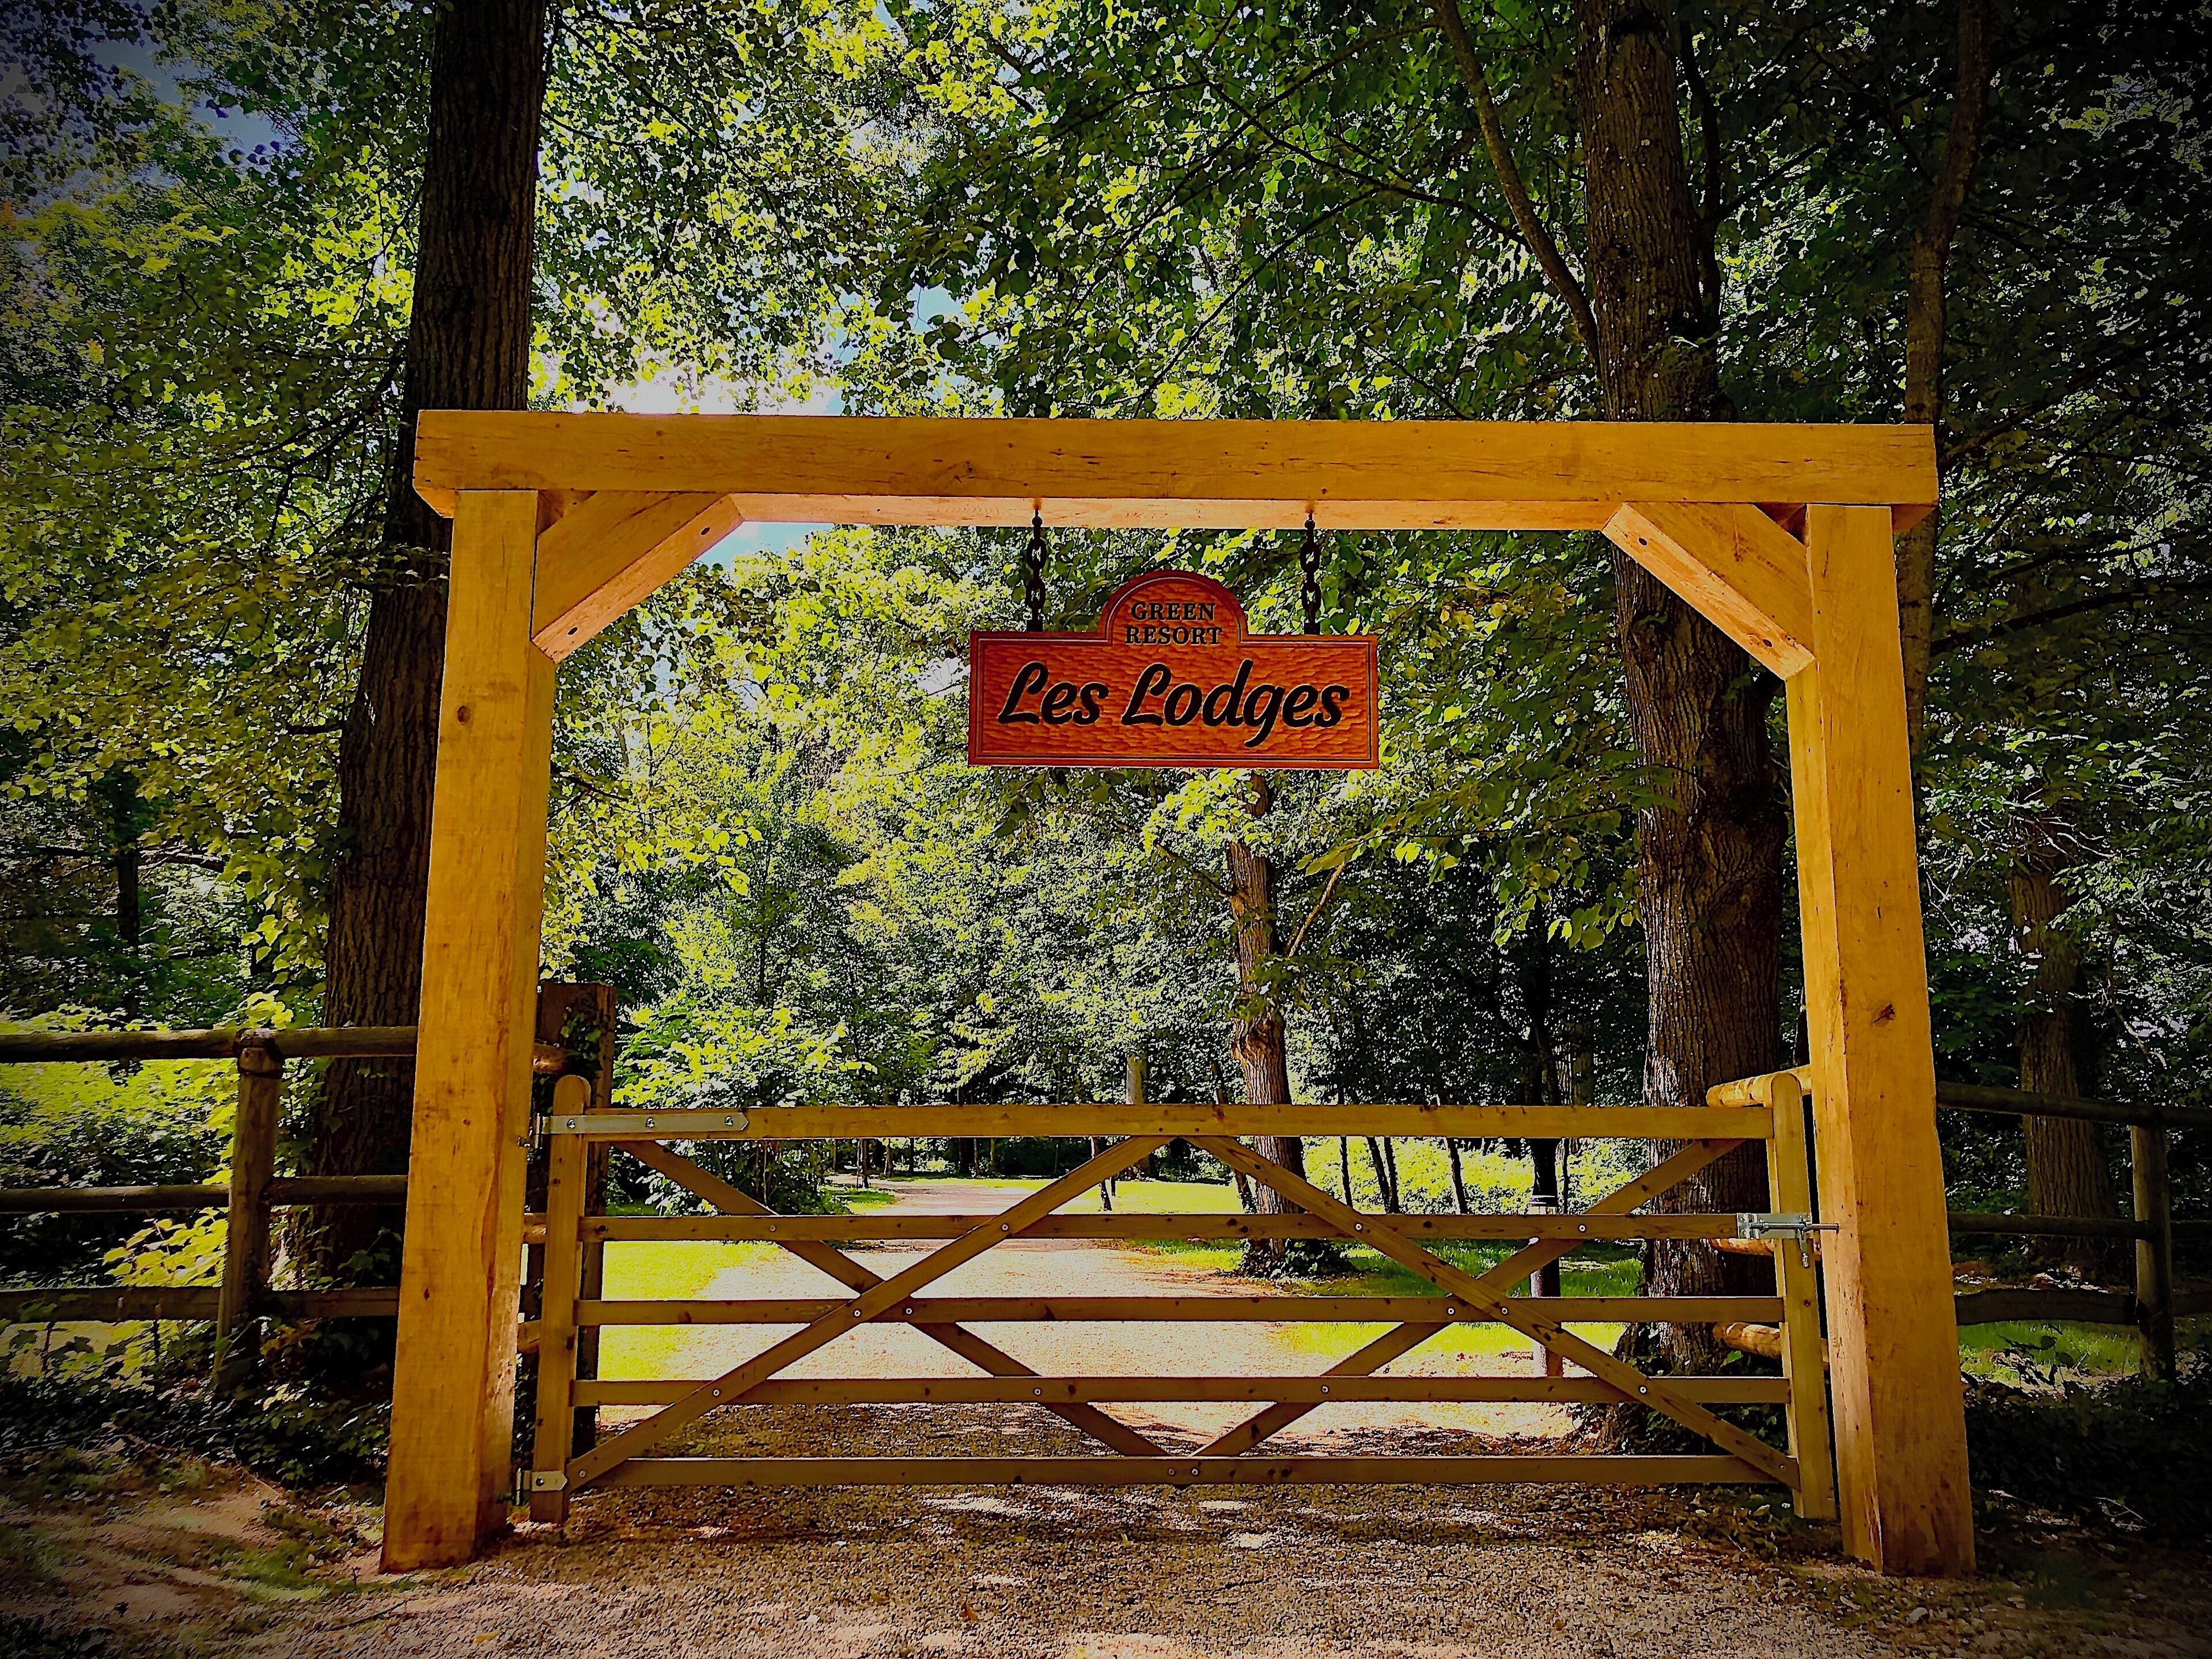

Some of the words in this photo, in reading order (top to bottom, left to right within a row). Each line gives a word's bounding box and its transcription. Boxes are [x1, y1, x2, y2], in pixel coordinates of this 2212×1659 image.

[1130, 602, 1215, 621] GREEN
[1124, 626, 1223, 646] RESORT
[998, 662, 1109, 725] Les
[1121, 659, 1350, 748] Lodges
